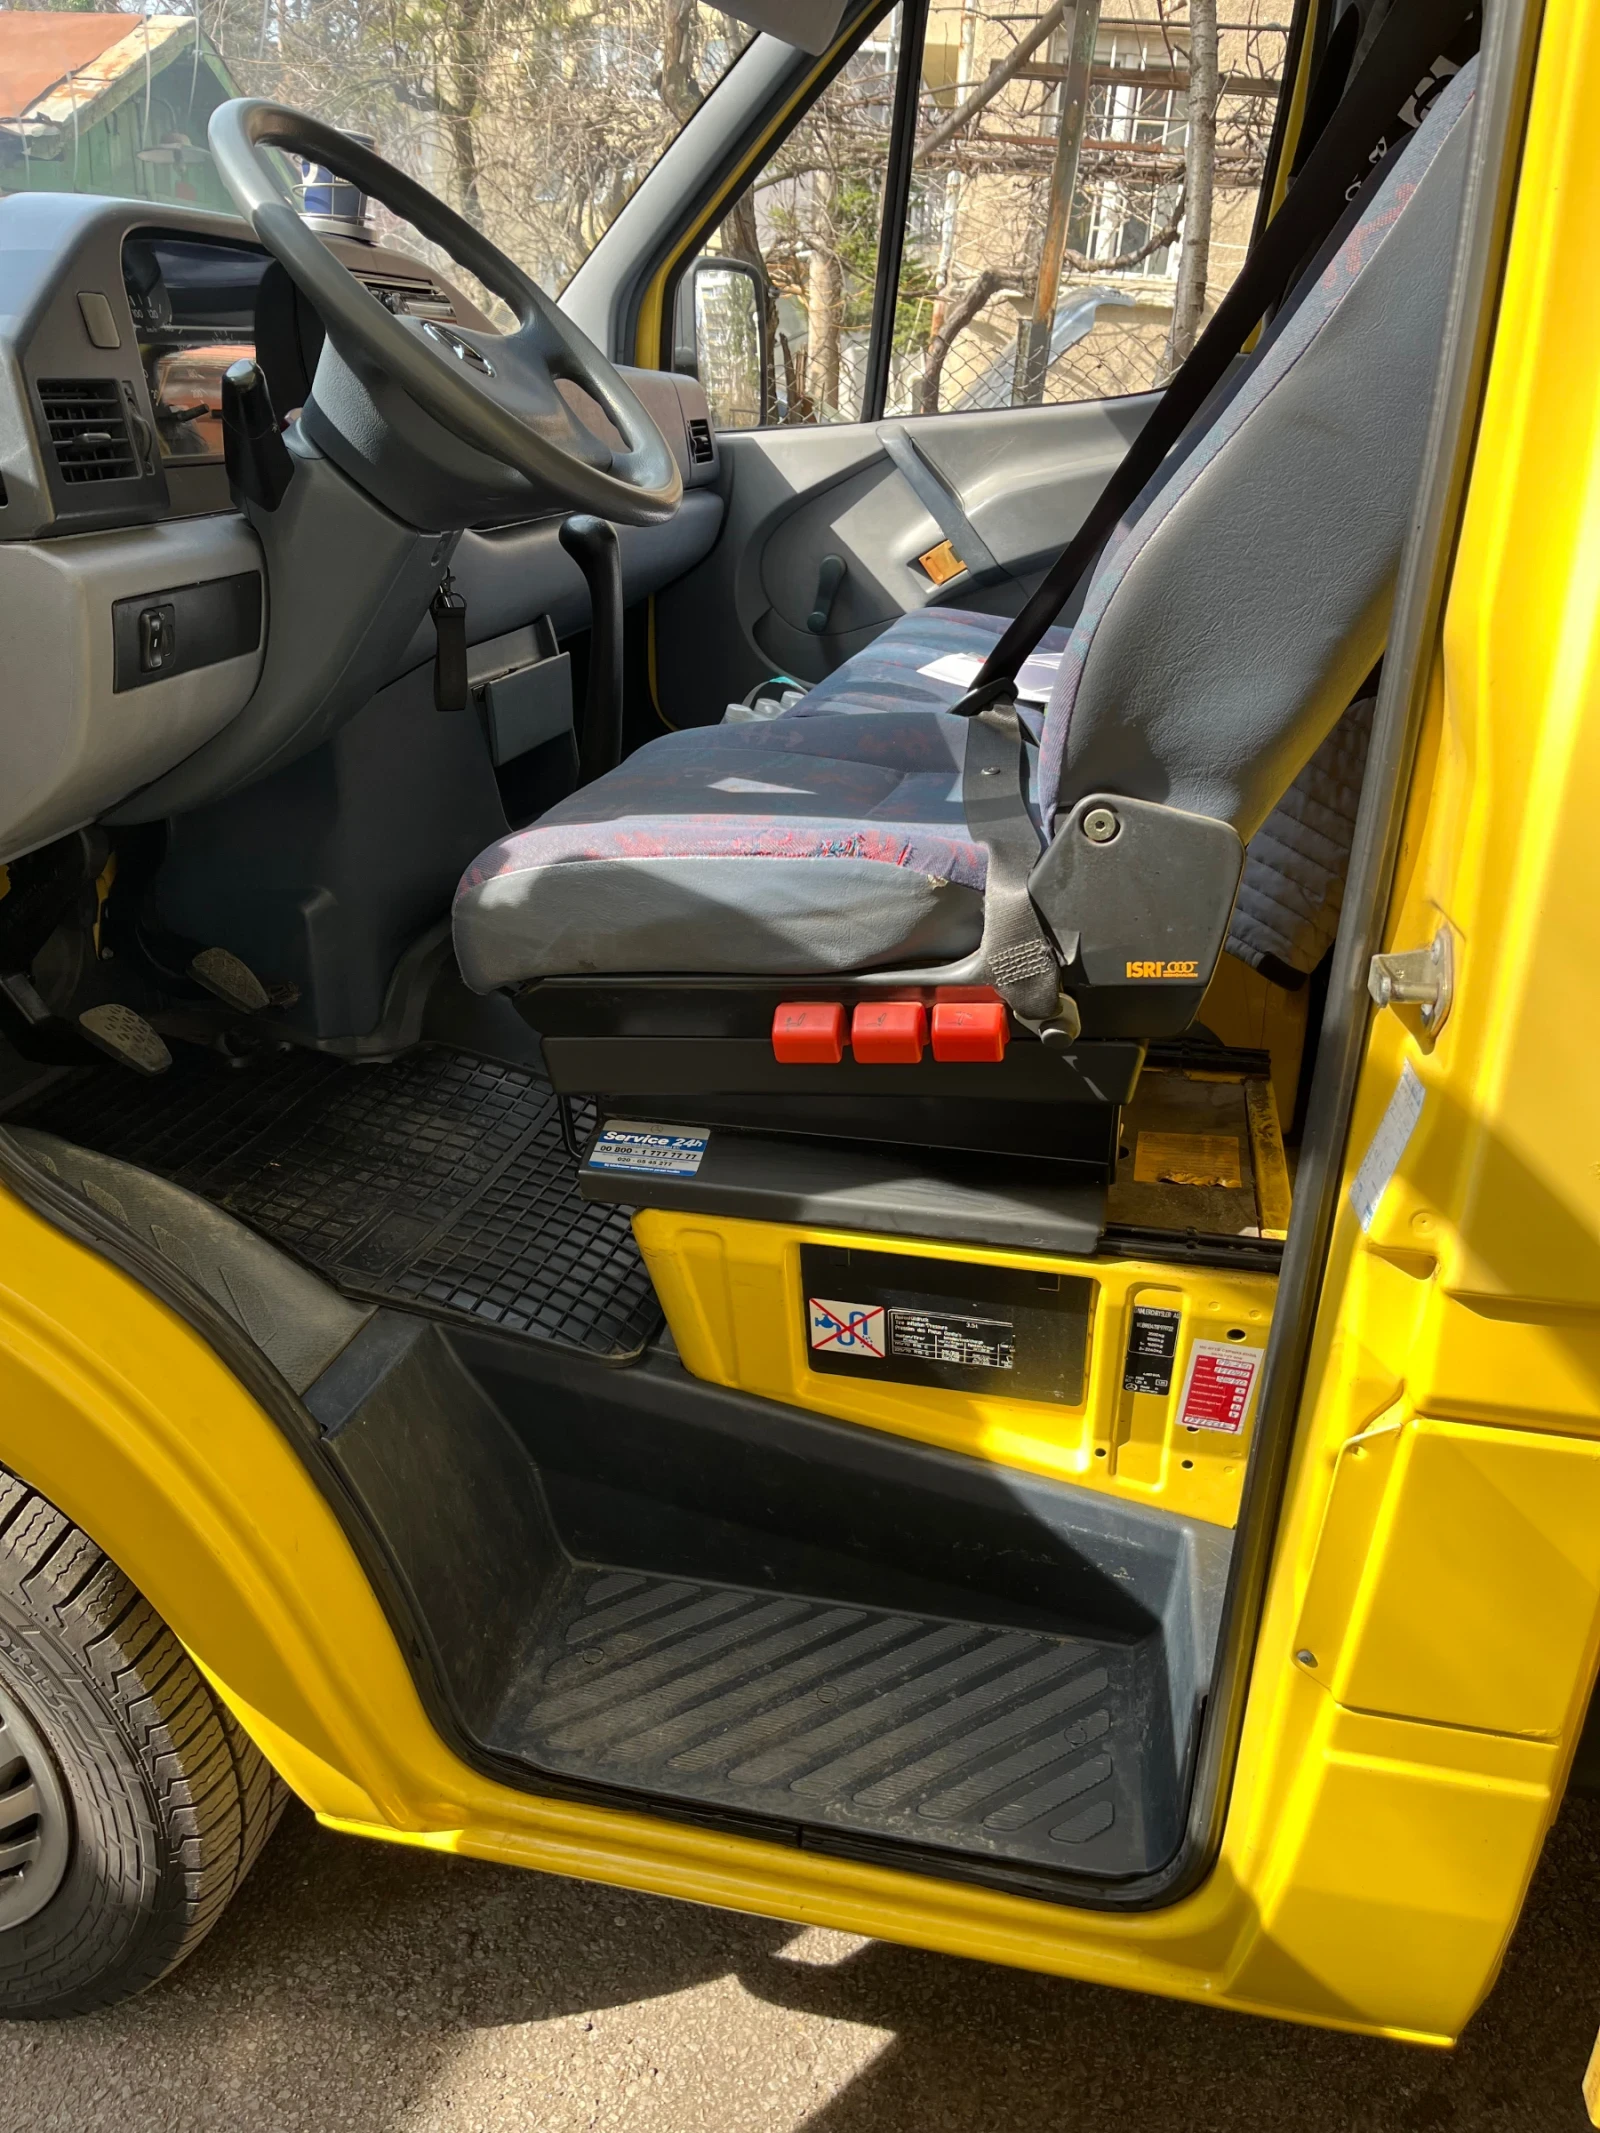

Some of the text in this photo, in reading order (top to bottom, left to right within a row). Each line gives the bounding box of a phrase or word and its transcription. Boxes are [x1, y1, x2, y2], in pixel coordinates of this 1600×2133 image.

[1126, 961, 1162, 978] ISRI
[603, 1131, 670, 1145] Service
[671, 1138, 703, 1148] 24h
